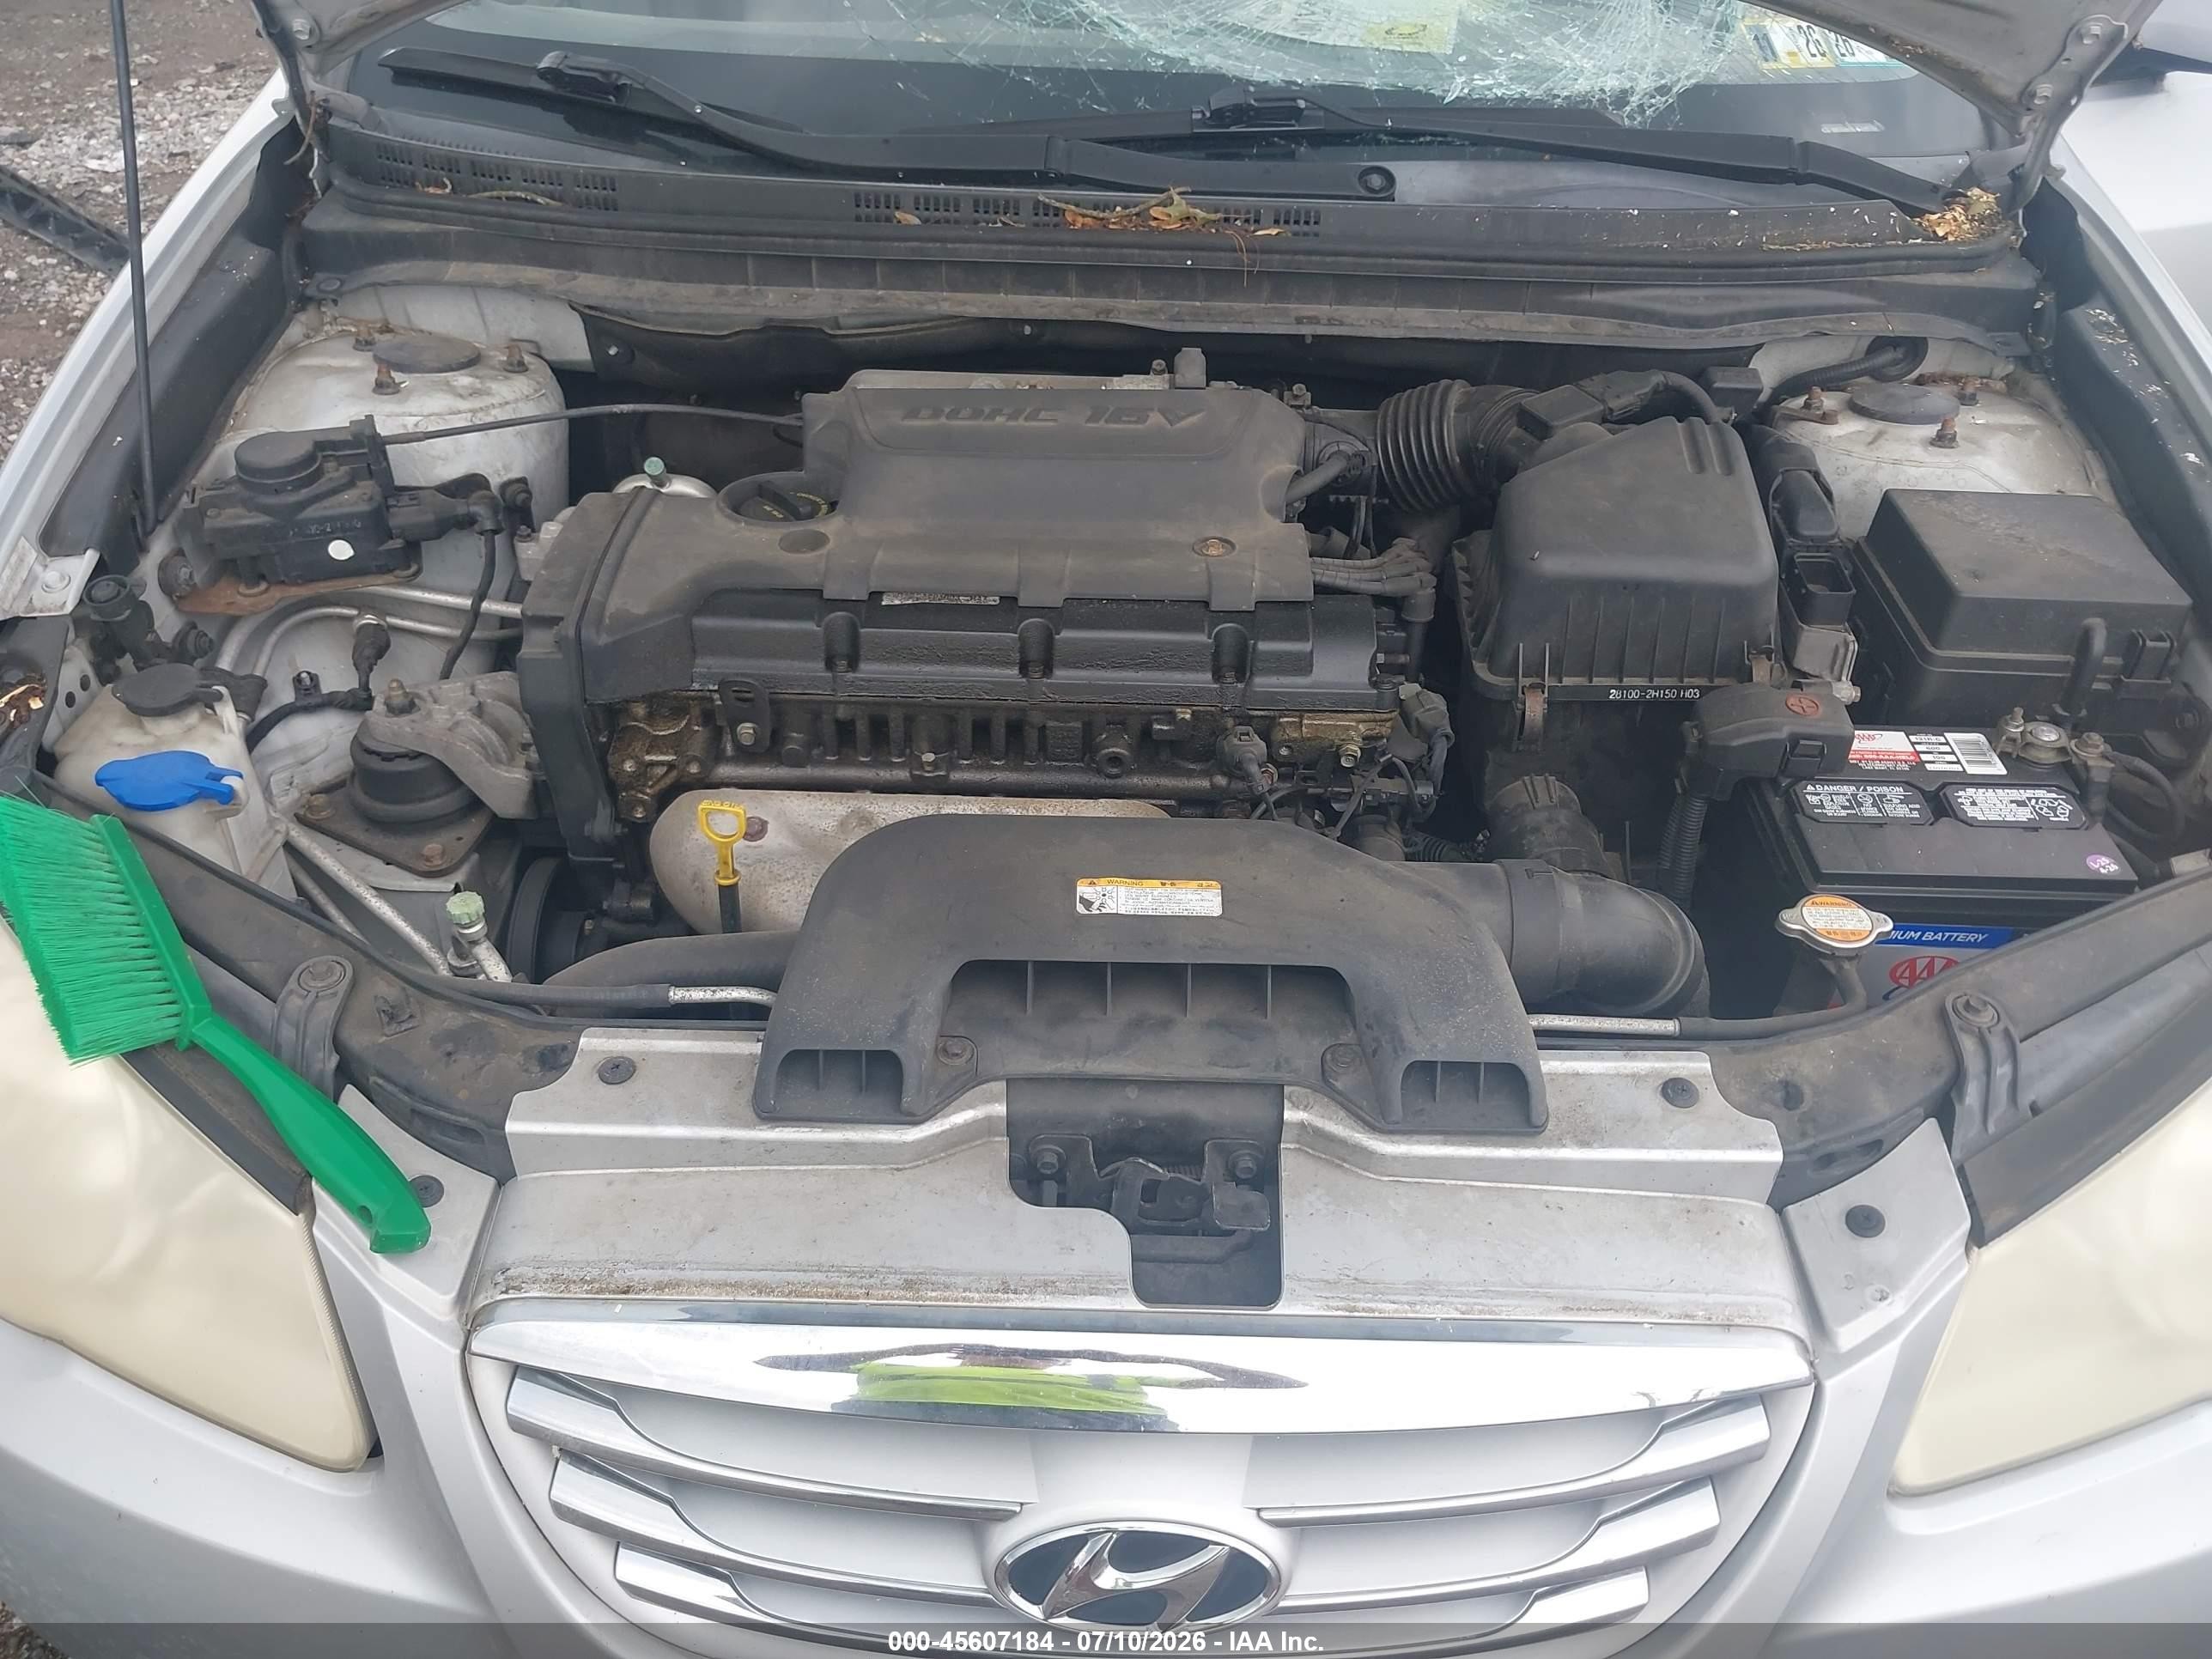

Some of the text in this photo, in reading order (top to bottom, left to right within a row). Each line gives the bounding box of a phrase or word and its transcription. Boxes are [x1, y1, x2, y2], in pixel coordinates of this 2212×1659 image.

[902, 405, 1204, 427] DOHC 16V
[1608, 689, 1700, 700] 28100-2H150 H03
[1922, 930, 1989, 943] BATTERY
